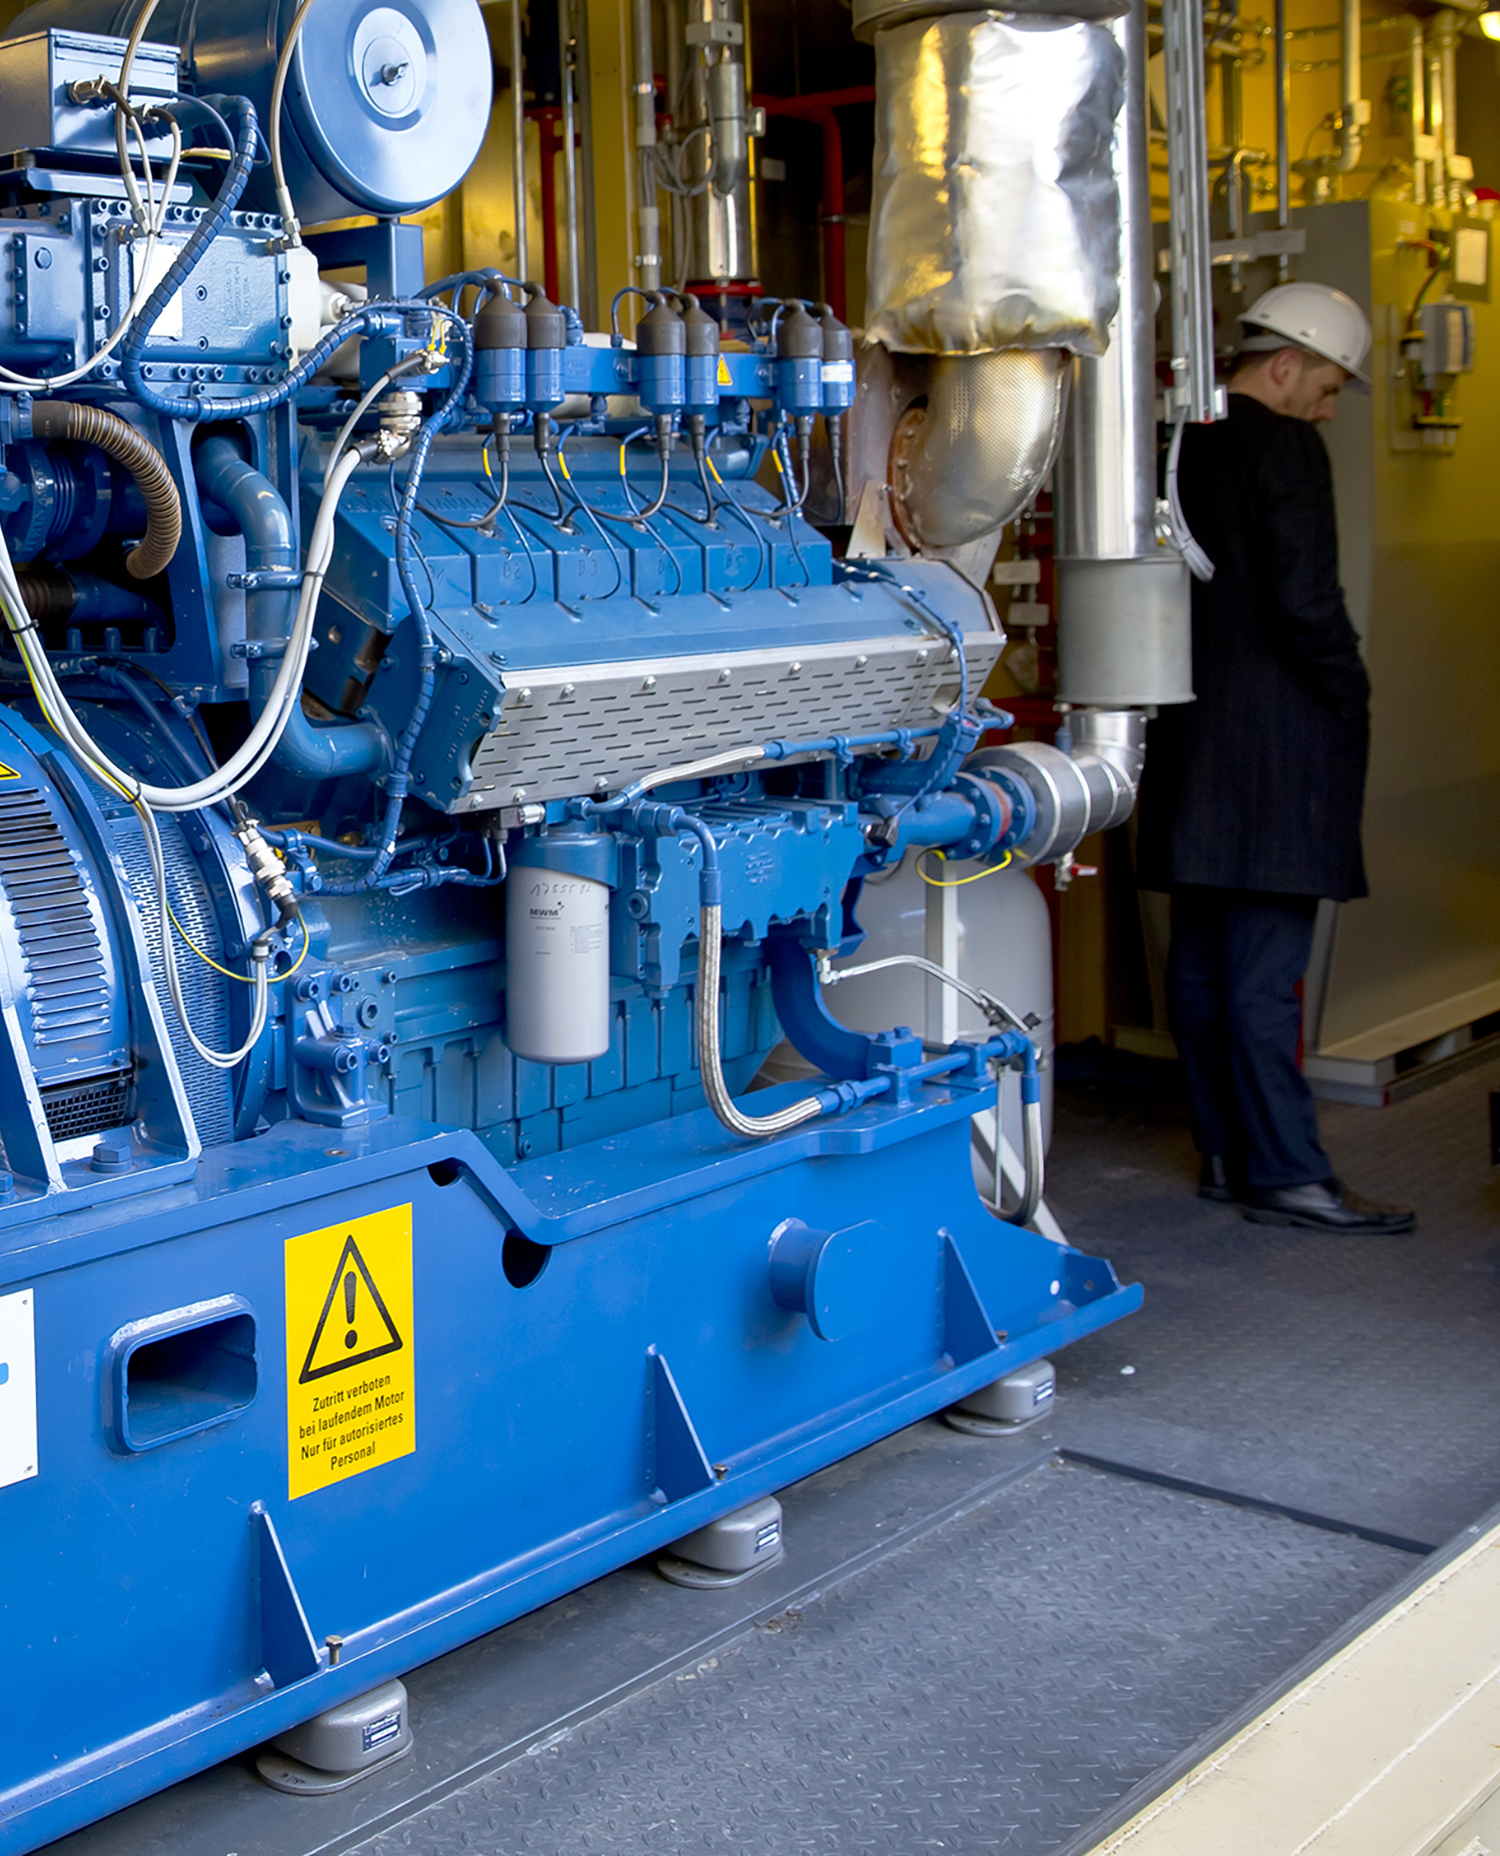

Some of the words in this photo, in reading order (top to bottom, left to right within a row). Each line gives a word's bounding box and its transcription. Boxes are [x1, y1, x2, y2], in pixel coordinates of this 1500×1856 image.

[503, 561, 521, 580] B2
[579, 559, 598, 577] B3
[529, 908, 559, 916] MWM
[313, 1390, 344, 1412] Zutritt
[346, 1375, 391, 1399] verboten
[299, 1420, 316, 1439] bei
[318, 1403, 373, 1432] laufendem
[375, 1391, 405, 1411] Motor
[301, 1444, 320, 1460] Nur
[322, 1436, 338, 1452] für
[340, 1412, 404, 1445] autorisiertes
[331, 1441, 376, 1470] Personal
